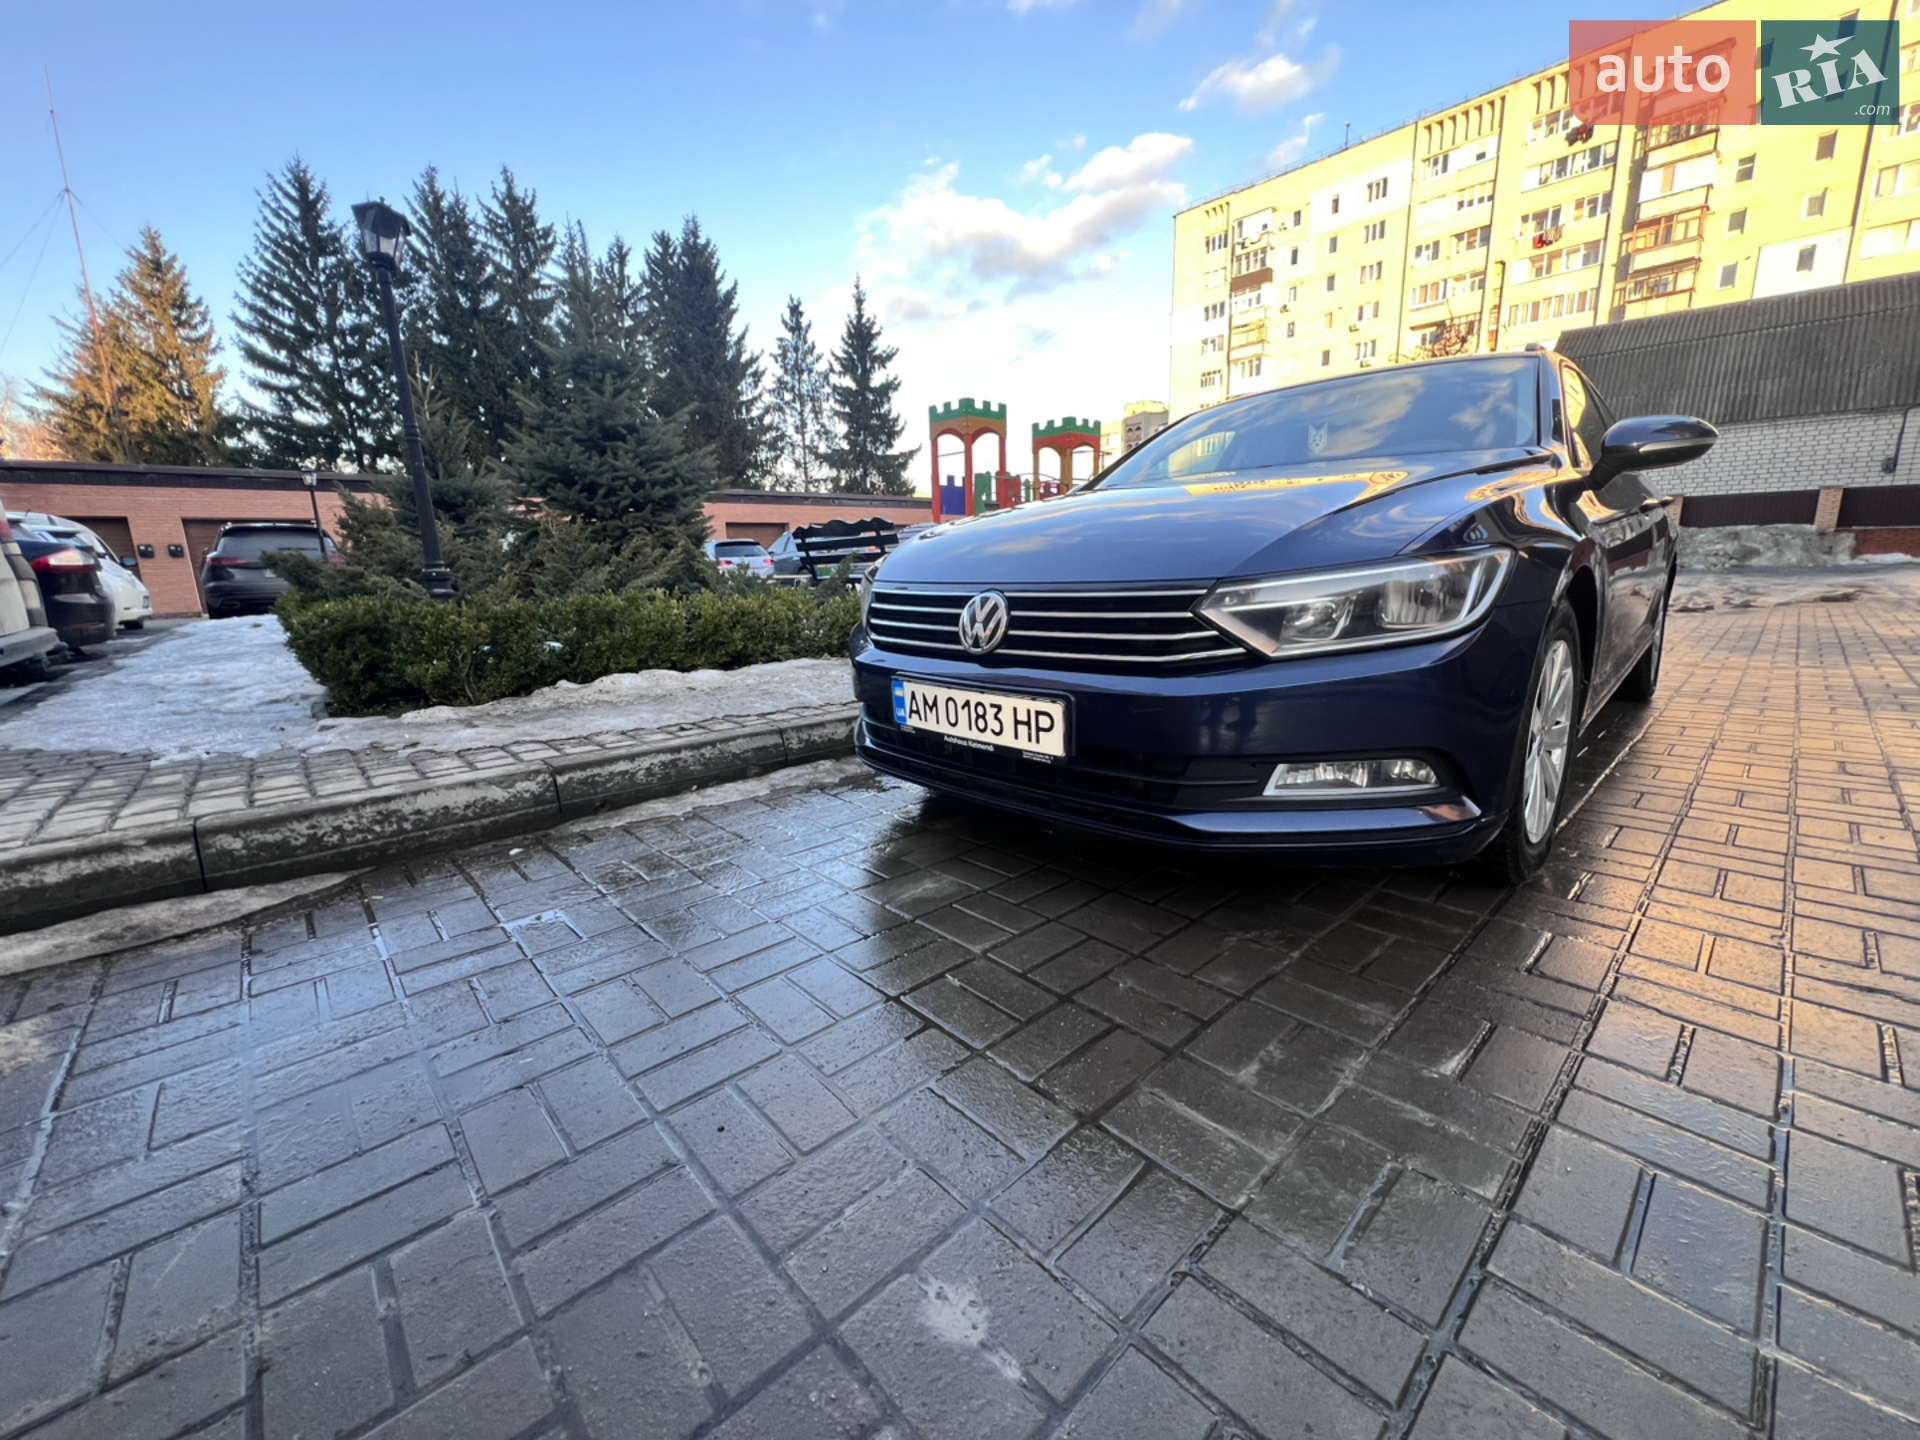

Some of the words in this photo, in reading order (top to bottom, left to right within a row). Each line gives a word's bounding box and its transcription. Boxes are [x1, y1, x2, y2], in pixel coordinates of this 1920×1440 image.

[909, 690, 940, 725] AM
[945, 696, 1004, 737] 0183
[1013, 707, 1055, 744] HP
